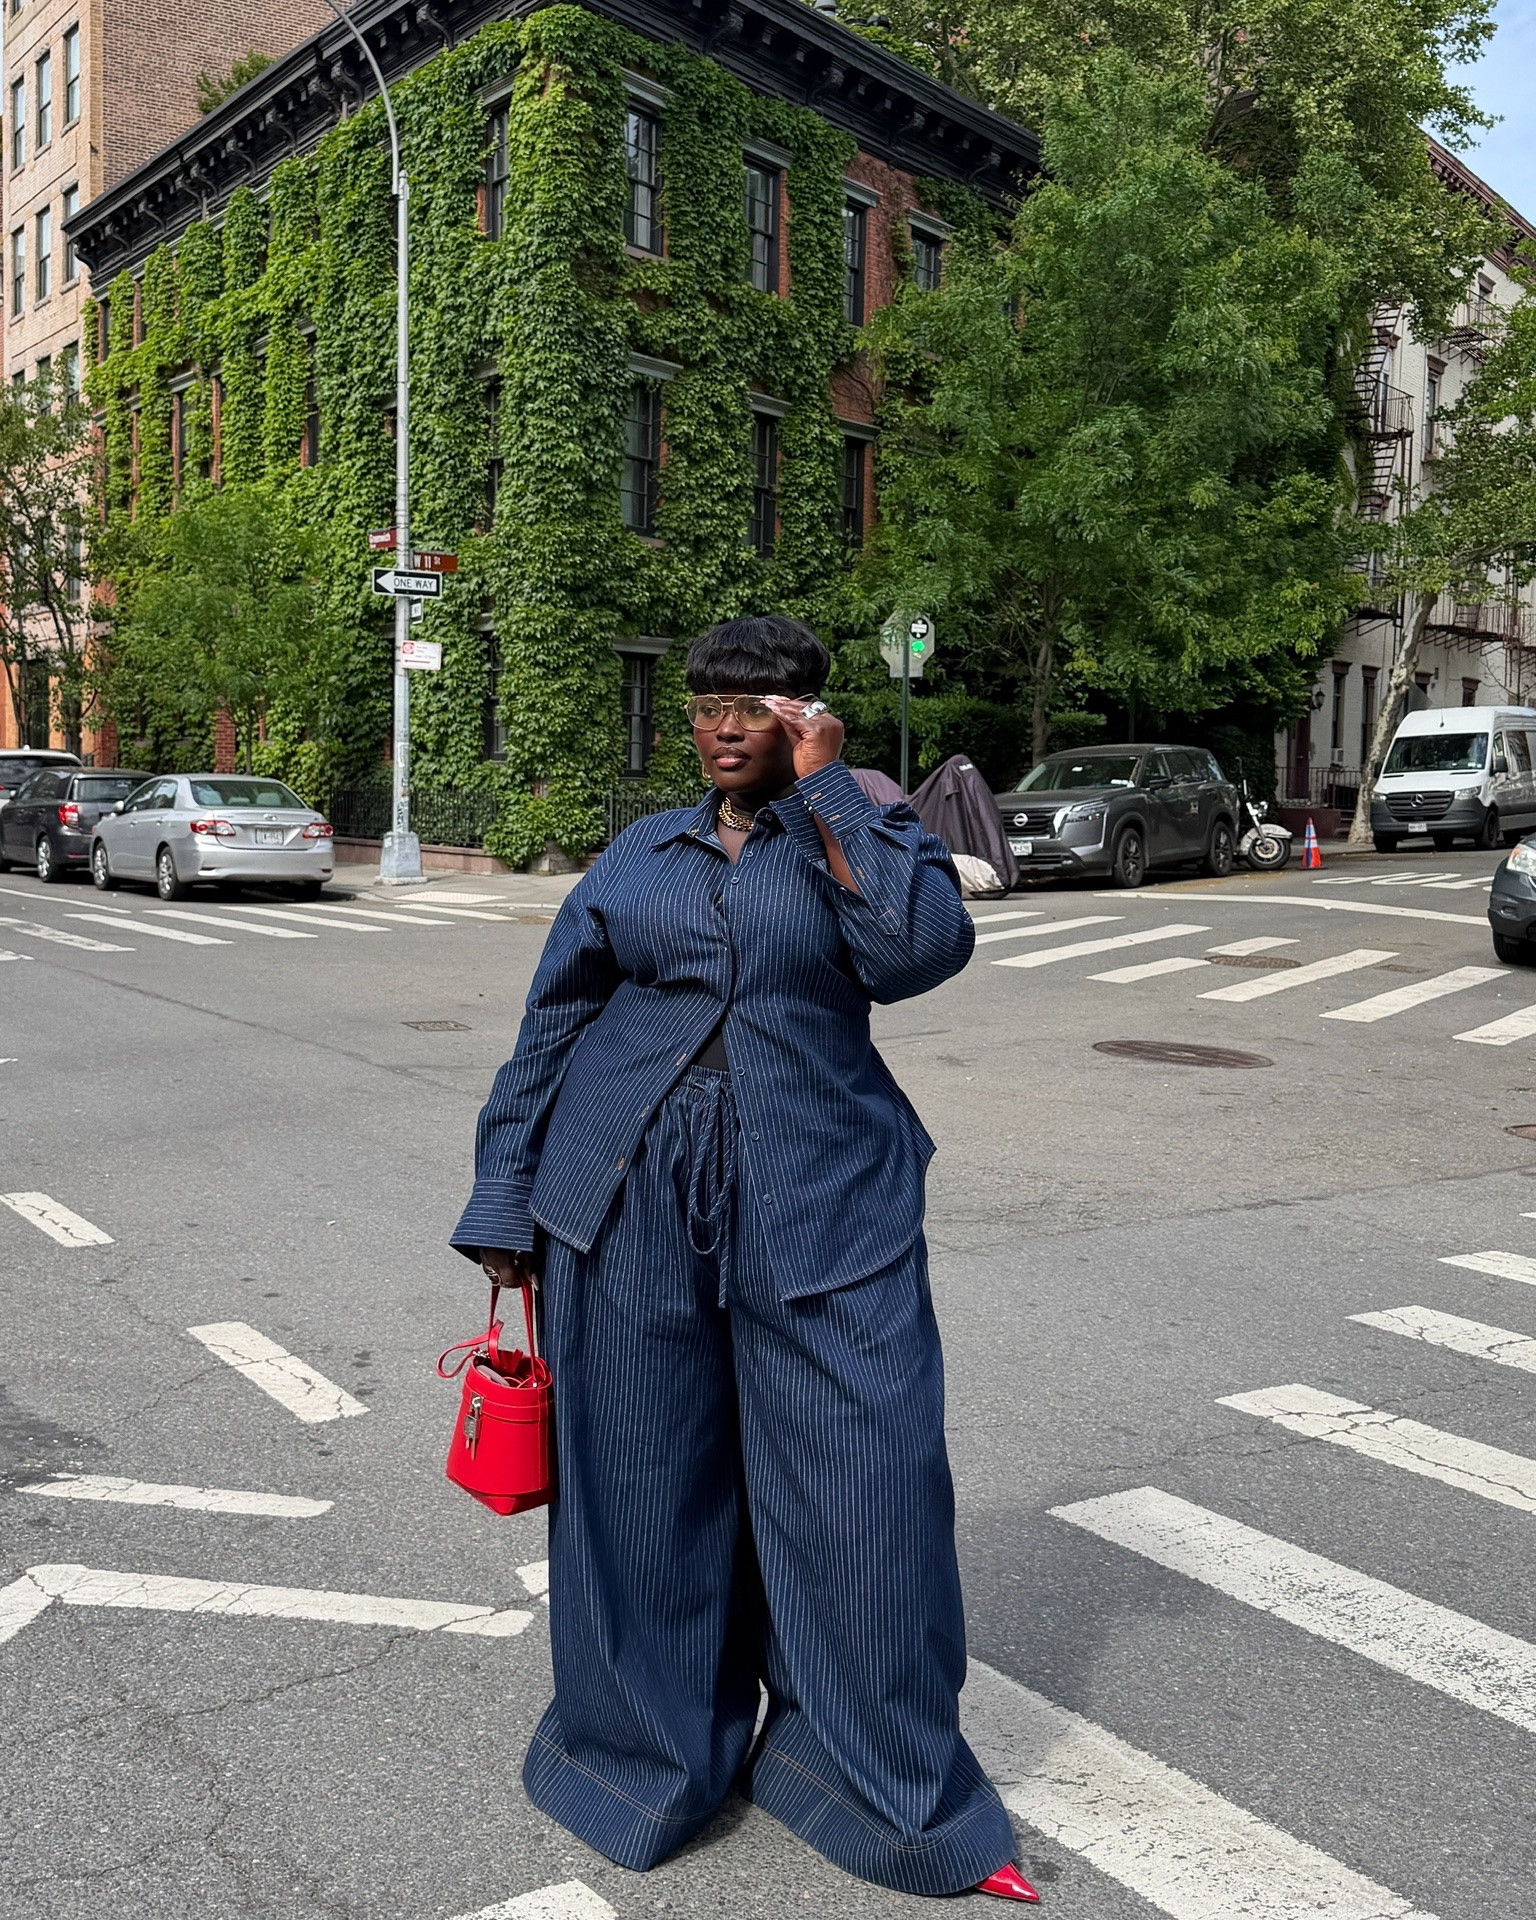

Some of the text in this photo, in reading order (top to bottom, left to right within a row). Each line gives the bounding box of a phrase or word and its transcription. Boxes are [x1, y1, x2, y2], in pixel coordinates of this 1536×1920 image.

[414, 555, 421, 568] W
[424, 555, 431, 568] 11
[394, 577, 433, 589] ONE WAY
